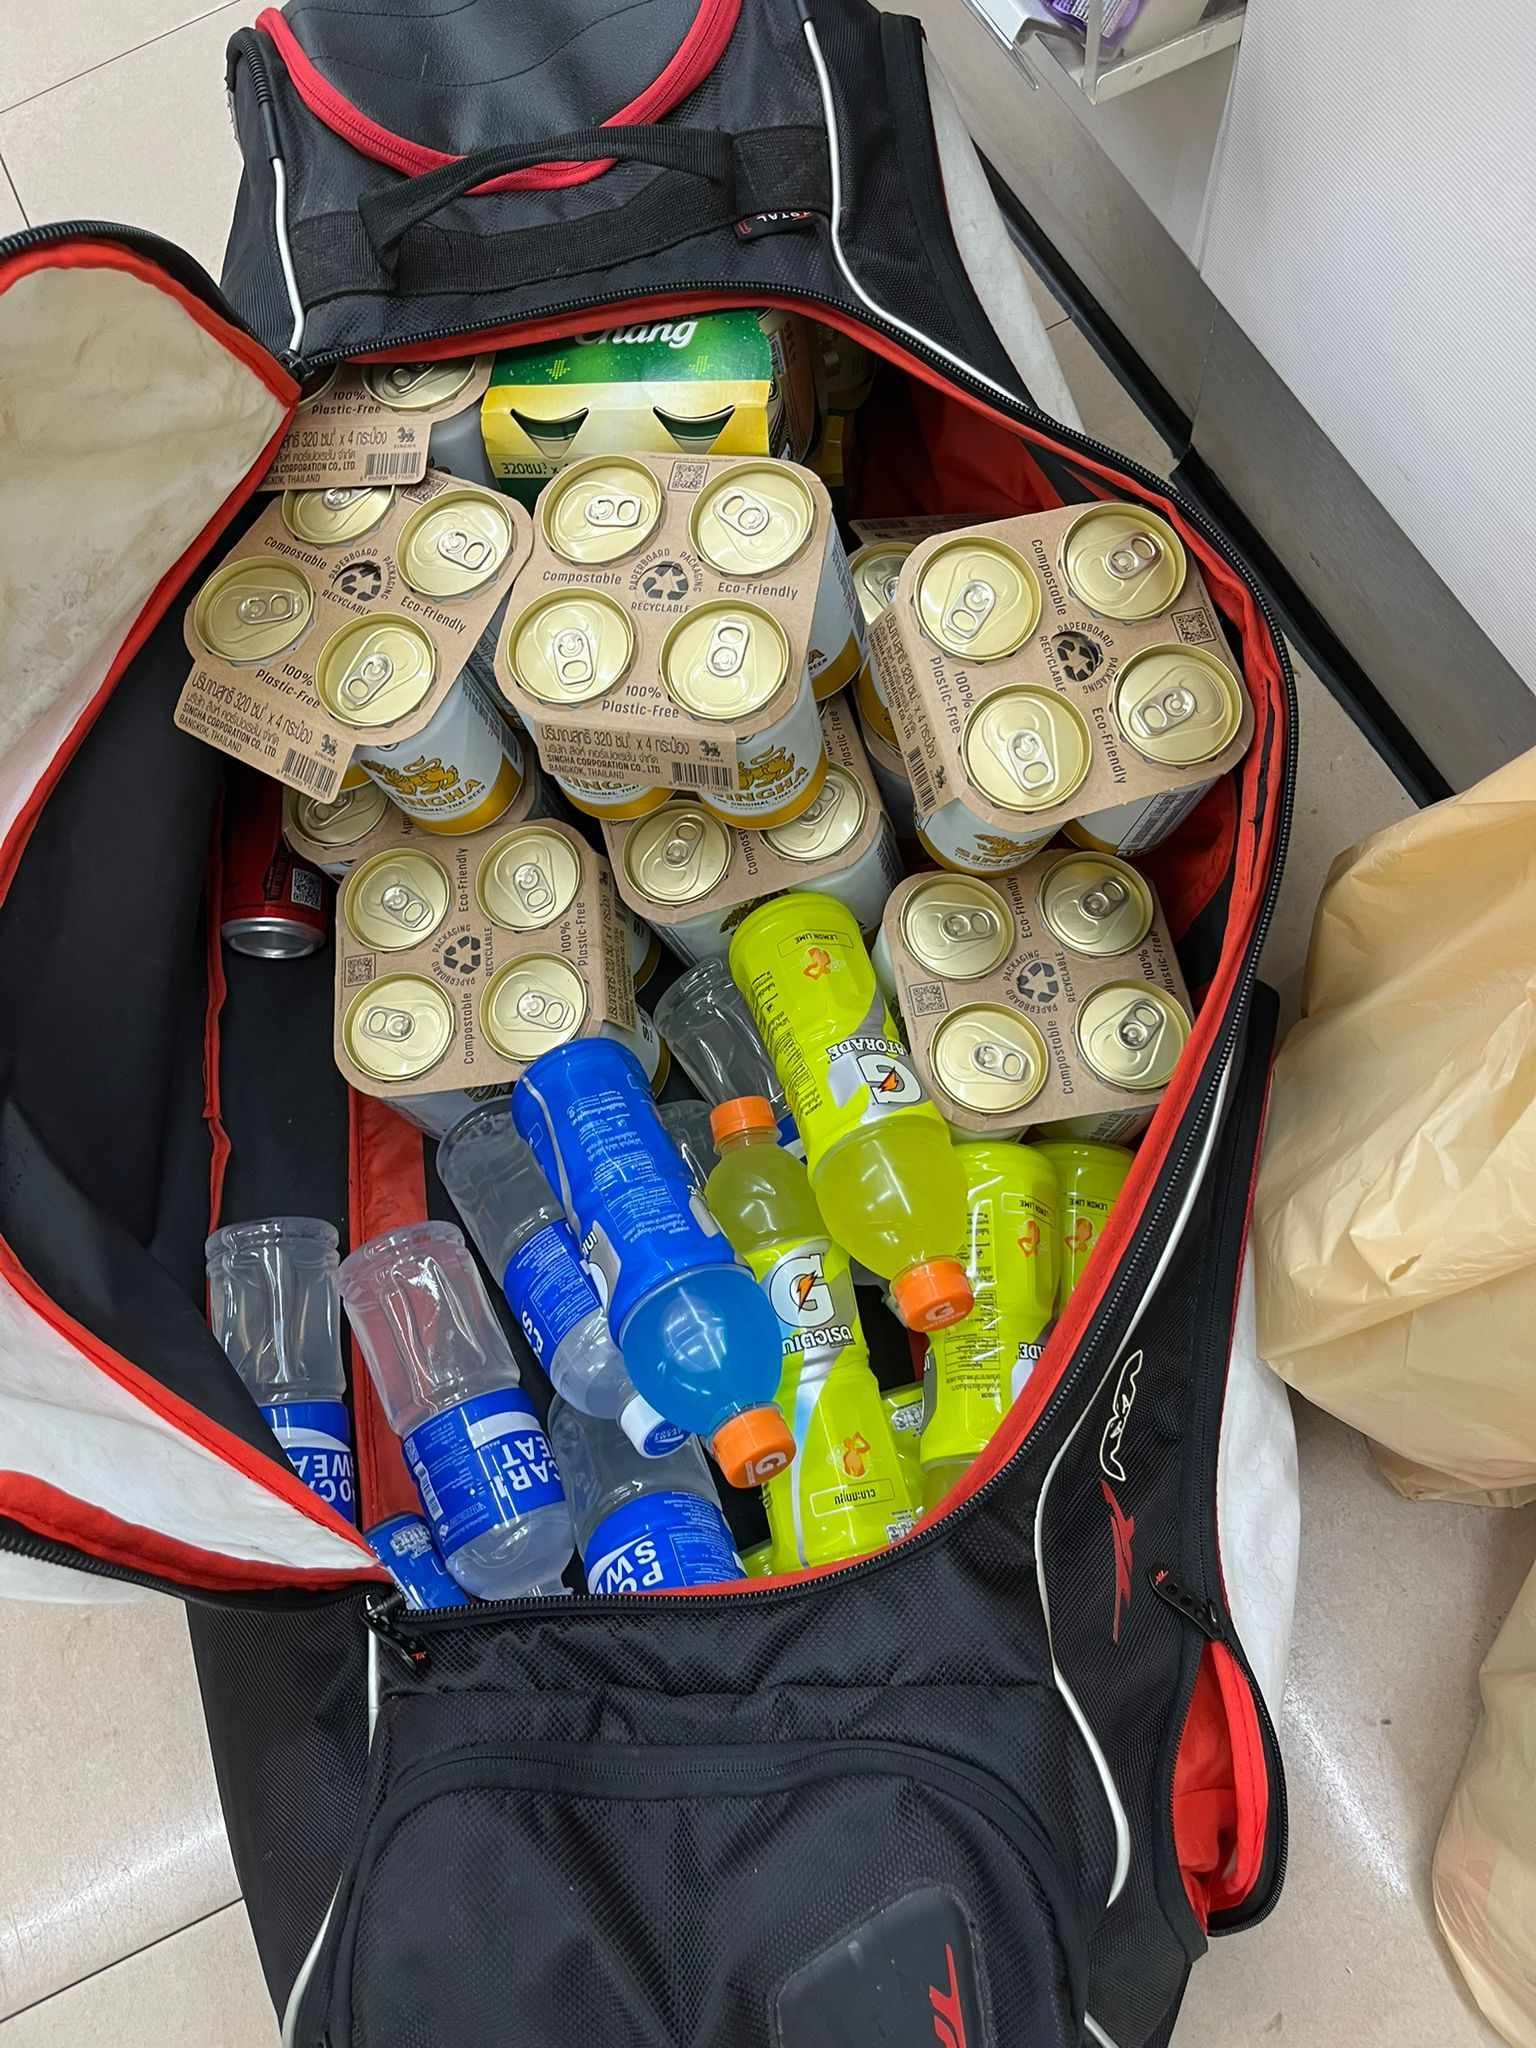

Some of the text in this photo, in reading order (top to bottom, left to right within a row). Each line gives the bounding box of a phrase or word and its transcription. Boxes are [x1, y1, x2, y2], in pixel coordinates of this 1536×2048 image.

[311, 404, 381, 415] Plastic-Free
[333, 391, 366, 400] 100%
[302, 432, 319, 447] 320
[348, 431, 354, 443] 4
[263, 536, 328, 570] Compostable
[328, 548, 378, 579] PAPERBOARD
[629, 548, 670, 591] PAPERBOARD
[382, 555, 397, 600] PACKAGING
[542, 570, 622, 586] Compostable
[680, 551, 704, 593] PACKAGING
[1031, 539, 1067, 616] Compostable
[718, 582, 799, 600] Eco-Friendly
[400, 596, 467, 635] Eco-Friendly
[1056, 621, 1114, 648] PAPERBOARD
[281, 663, 314, 686] 100%
[1039, 635, 1067, 693] RECYCLABLE
[1082, 657, 1119, 695] PACKAGING
[255, 668, 321, 709] Plastic-Free
[625, 685, 662, 699] 100%
[900, 664, 914, 684] 320
[916, 714, 926, 724] 4
[929, 656, 961, 735] Plastic-Free
[954, 670, 977, 709] 100%
[182, 703, 207, 723] SINGHA
[206, 715, 251, 745] CORPORATION
[233, 692, 252, 712] 320
[275, 714, 284, 727] 4
[602, 700, 680, 719] Plastic-Free
[210, 728, 242, 753] THAILAND
[593, 731, 613, 748] 320
[645, 737, 652, 748] 4
[829, 711, 854, 767] Plastic-Free
[1092, 706, 1128, 784] Eco-Friendly
[547, 754, 576, 765] SINGHA
[576, 757, 630, 771] CORPORATION
[588, 768, 625, 780] THAILAND
[722, 766, 808, 801] INGHA
[456, 848, 469, 912] Eco-Friendly
[1008, 877, 1032, 939] Eco-Friendly
[432, 924, 471, 953] PACKAGING
[561, 921, 572, 953] 100%
[576, 901, 589, 967] Plastic-Free
[795, 932, 839, 945] LEMON LIME
[484, 926, 494, 977] RECYCLABLE
[1003, 950, 1040, 982] PACKAGING
[1138, 949, 1155, 980] 100%
[431, 961, 476, 985] PAPERBOARD
[1055, 951, 1076, 1003] RECYCLABLE
[1006, 990, 1058, 1014] PAPERBOARD
[463, 992, 475, 1065] Compostable
[826, 1038, 908, 1062] ATORADE
[1047, 1020, 1074, 1095] Compostable
[856, 1053, 922, 1105] G
[1019, 1200, 1034, 1210] LIME
[1087, 1201, 1108, 1211] LEMON
[769, 1253, 836, 1329] G
[782, 1324, 855, 1357] กเตอเรด
[291, 1454, 353, 1479] WEA
[501, 1436, 551, 1470] EAT
